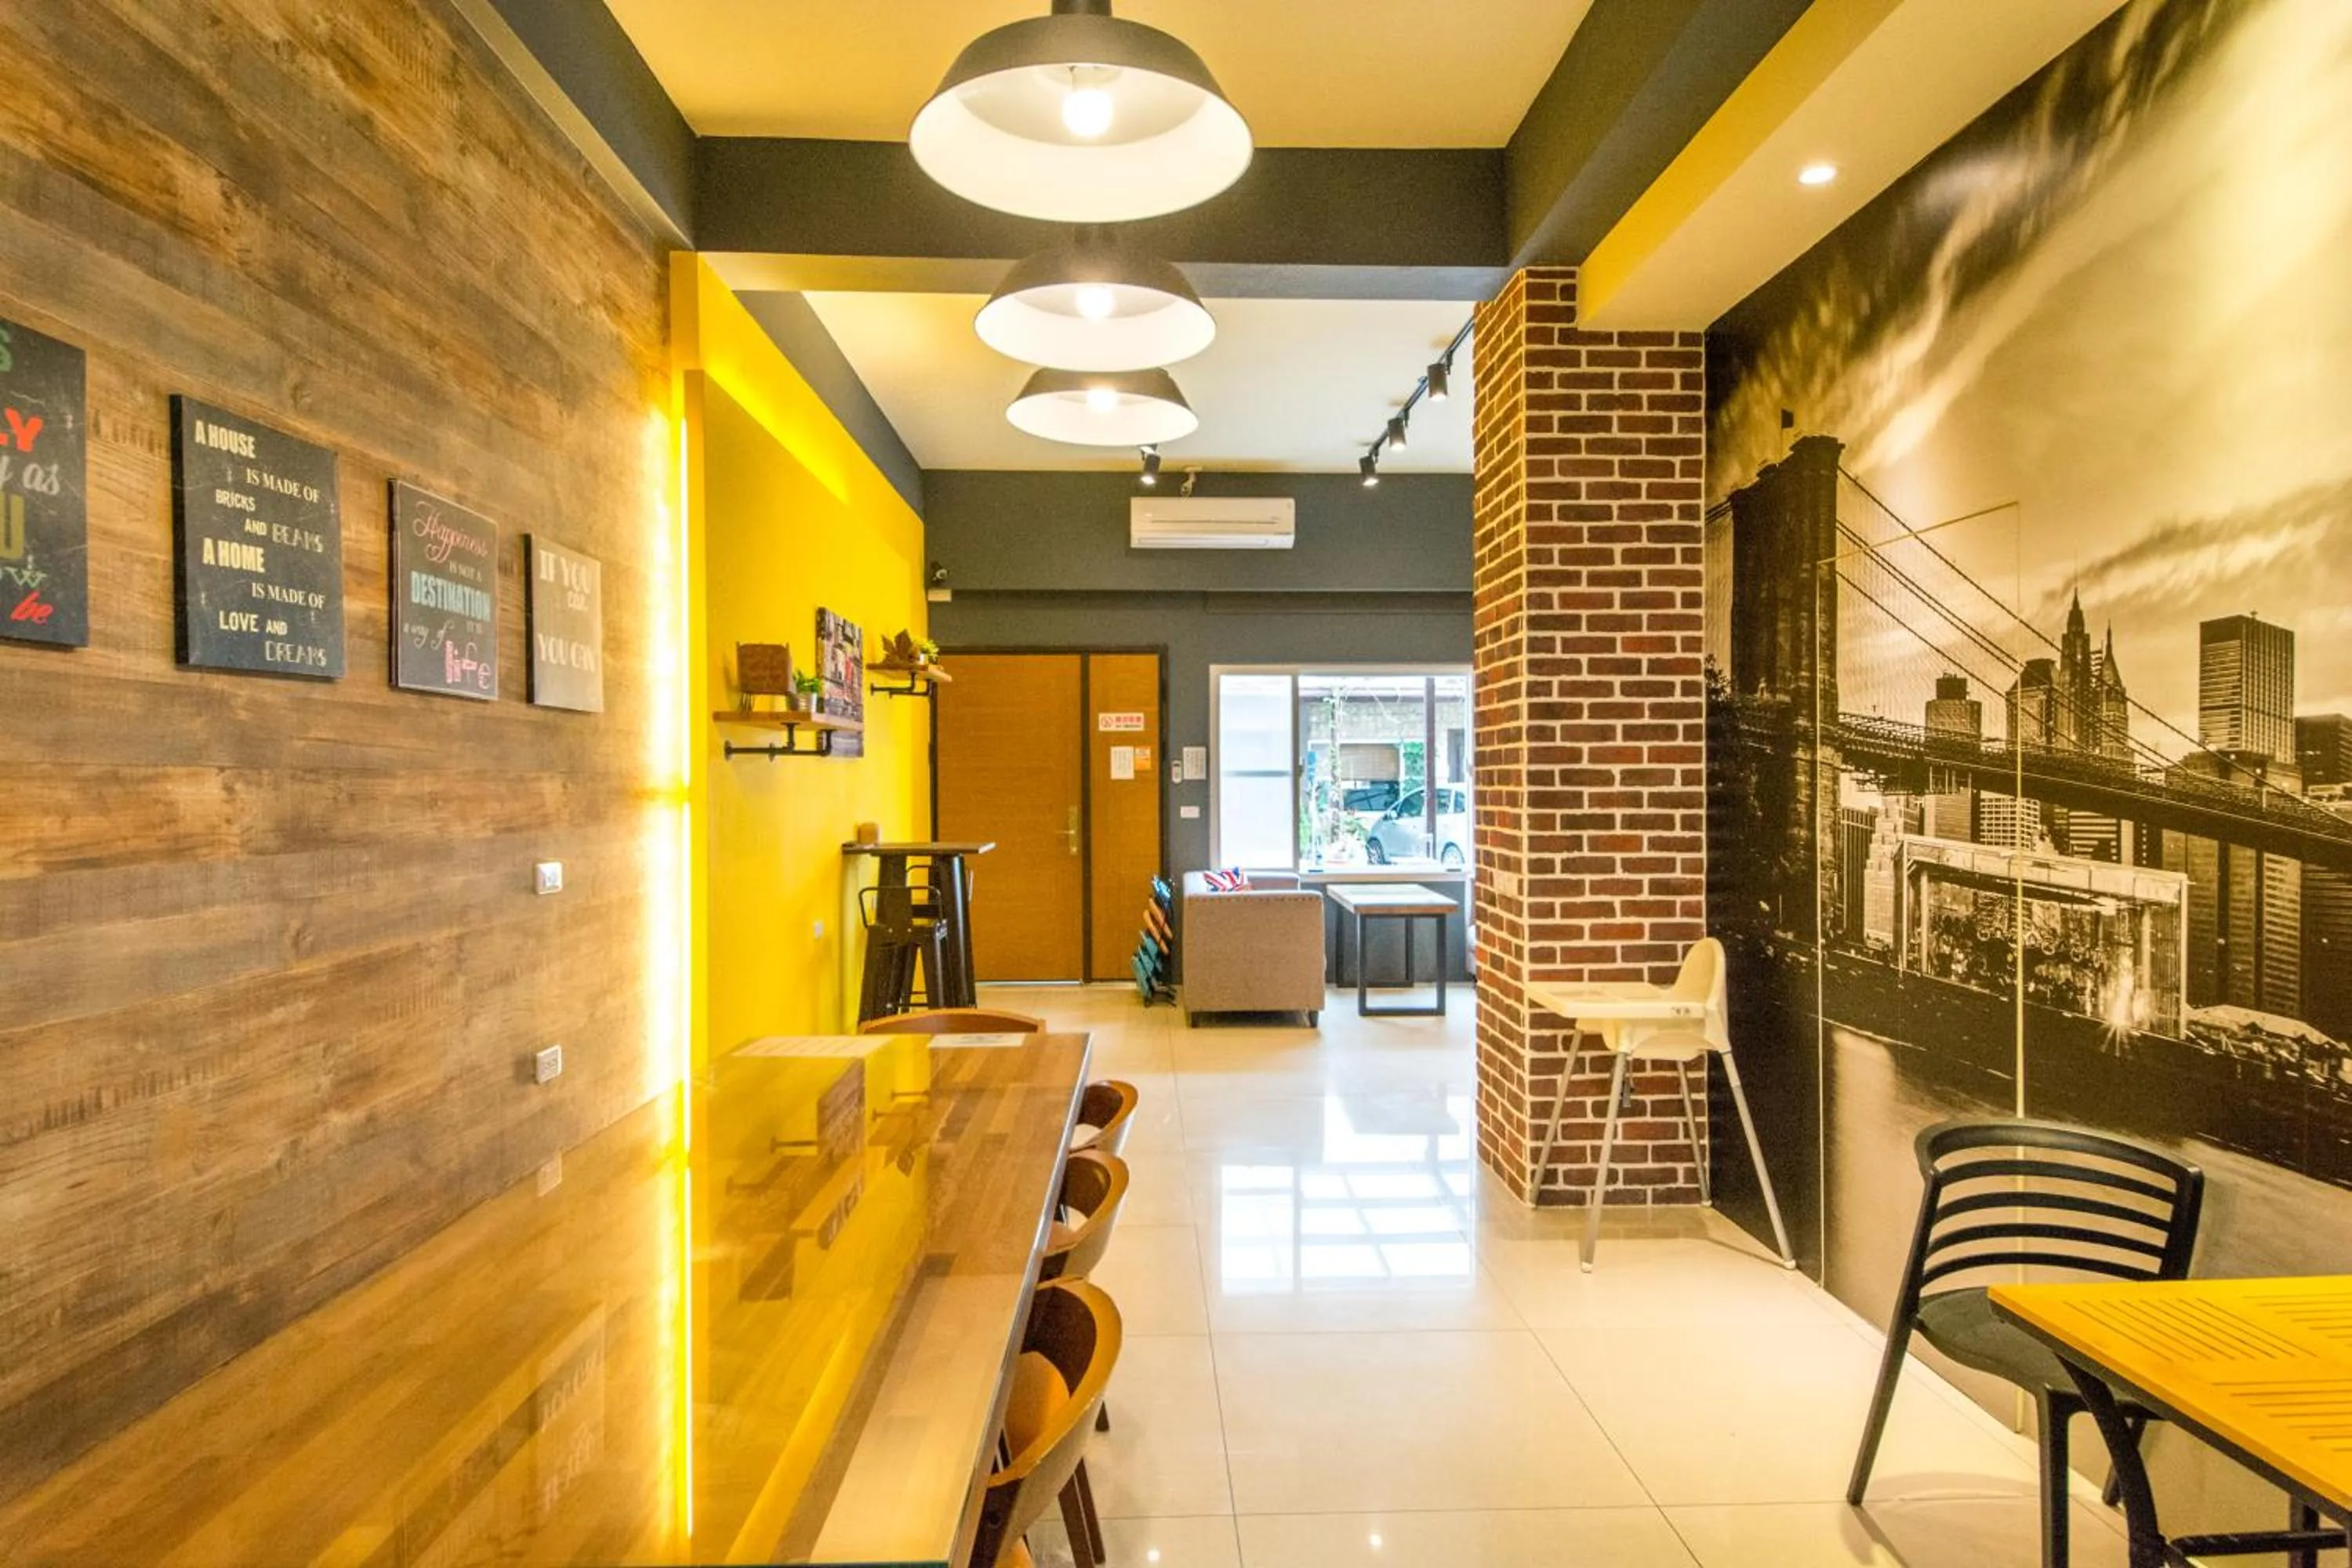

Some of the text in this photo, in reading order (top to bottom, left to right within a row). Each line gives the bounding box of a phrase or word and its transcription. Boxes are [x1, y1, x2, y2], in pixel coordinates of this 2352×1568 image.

[195, 419, 256, 459] A HOUSE
[216, 489, 256, 513] BRICKS
[245, 467, 321, 503] IS MADE OF
[245, 518, 267, 535] AND
[202, 537, 266, 573] A HOME
[539, 550, 593, 594] IF YOU
[10, 591, 53, 625] be
[252, 583, 326, 609] IS MADE OF
[411, 570, 490, 622] DESTINATION
[219, 610, 288, 636] LOVE AND
[265, 641, 327, 667] DREAMS
[537, 633, 568, 666] YOU
